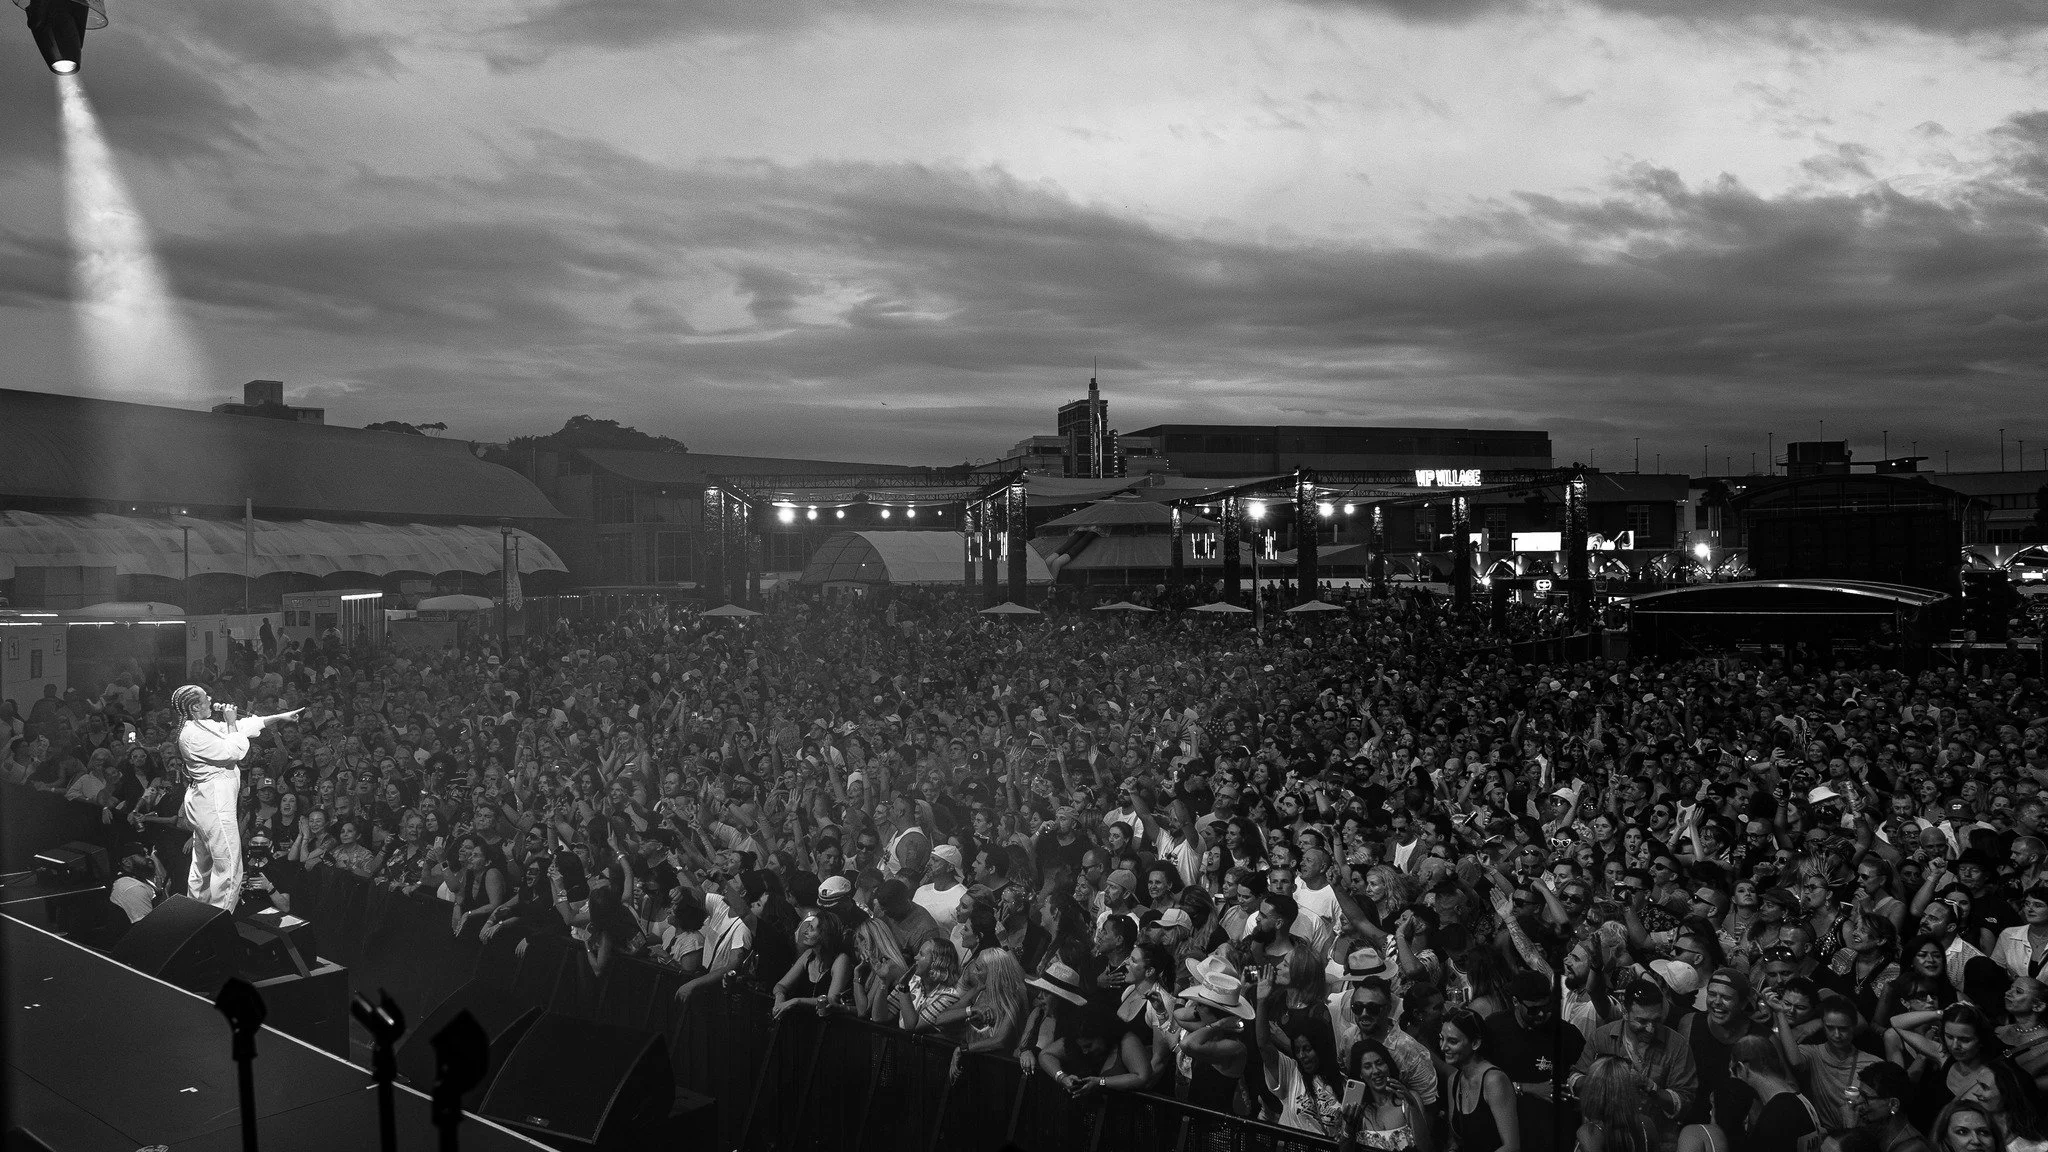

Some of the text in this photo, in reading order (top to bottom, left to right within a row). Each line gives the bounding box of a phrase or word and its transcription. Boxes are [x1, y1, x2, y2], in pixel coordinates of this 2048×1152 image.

[1415, 469, 1481, 487] VIP VILLAGE
[55, 638, 61, 652] 2
